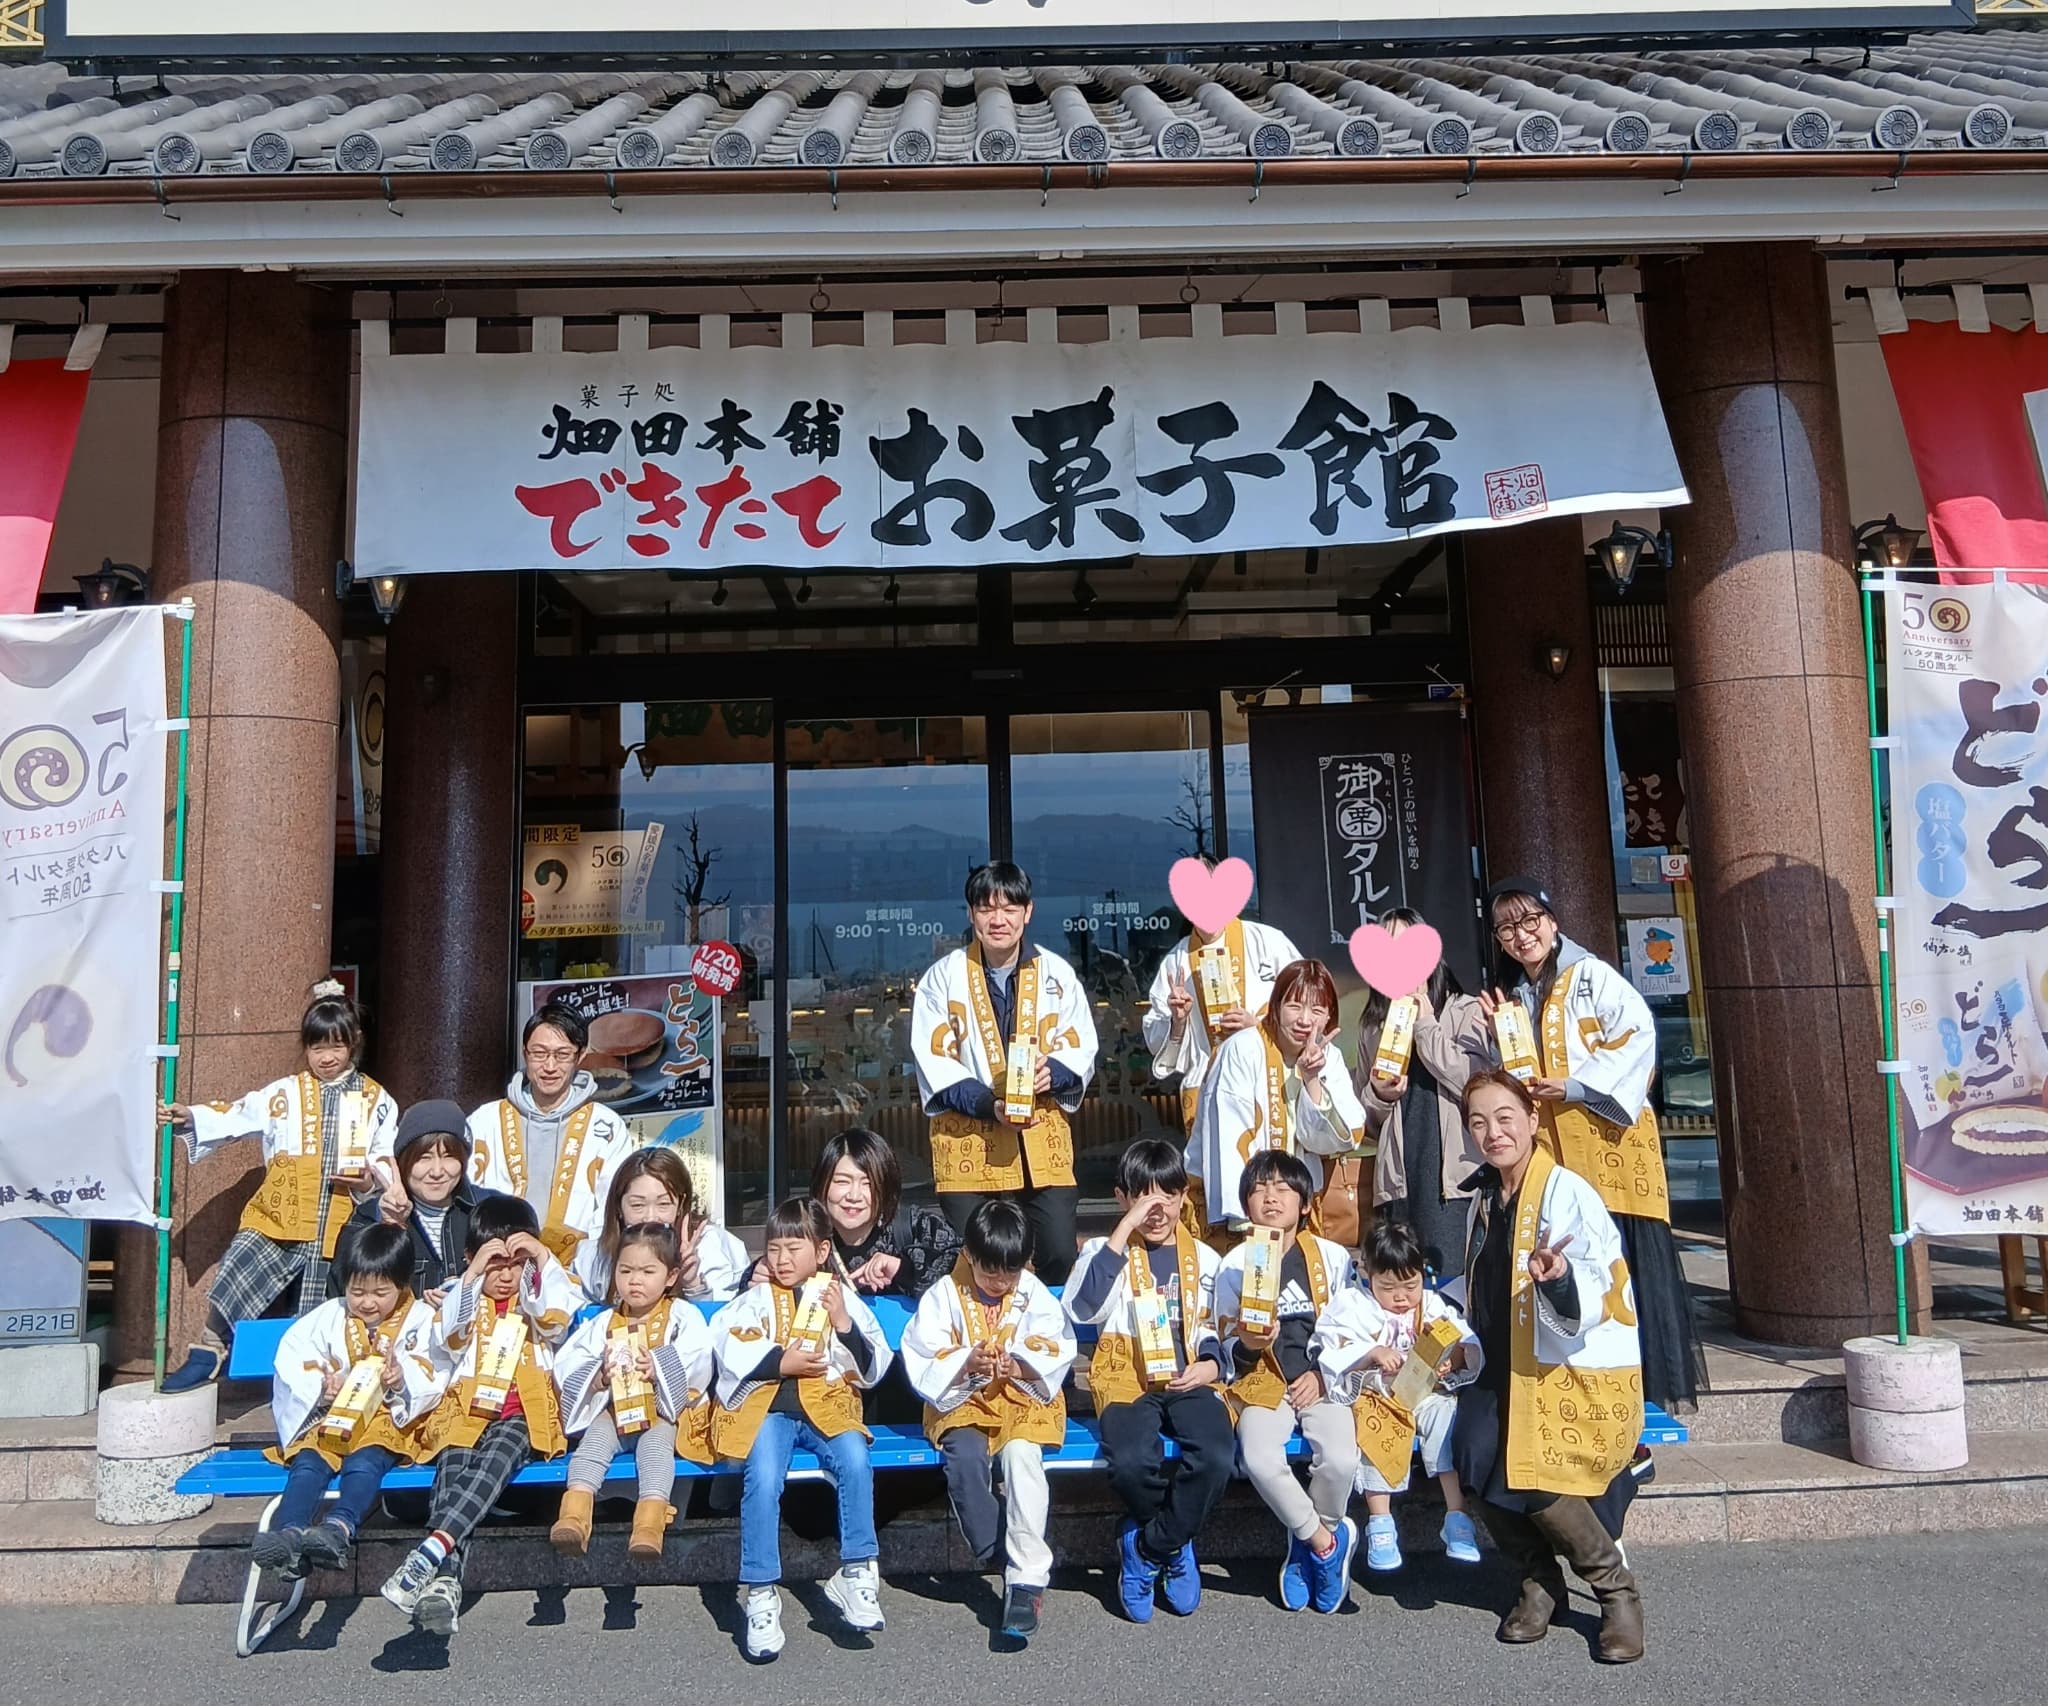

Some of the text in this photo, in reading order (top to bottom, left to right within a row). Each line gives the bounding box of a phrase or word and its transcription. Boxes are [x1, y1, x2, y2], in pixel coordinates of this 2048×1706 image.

[580, 382, 676, 409] 菓子処
[538, 398, 845, 465] 畑田本舗
[515, 380, 1459, 558] できたて お菓子館
[1903, 630, 1972, 647] Anniversary
[1903, 648, 1973, 664] ハタダ栗タルト
[1918, 659, 1958, 672] 50周年
[1401, 753, 1420, 870] ひとつ上の思いを贈る
[1928, 797, 1952, 883] 塩バター
[865, 908, 913, 922] 営業時間
[1092, 902, 1140, 916] 営業時間
[835, 923, 872, 939] 9:00
[897, 922, 944, 937] 19:00
[1063, 918, 1100, 933] 9:00
[1125, 916, 1171, 931] 19:00
[691, 960, 738, 992] 新発売
[658, 1087, 708, 1101] チョコレート
[1962, 1203, 2044, 1224] 畑田本舗
[6, 1313, 76, 1333] 2月21日
